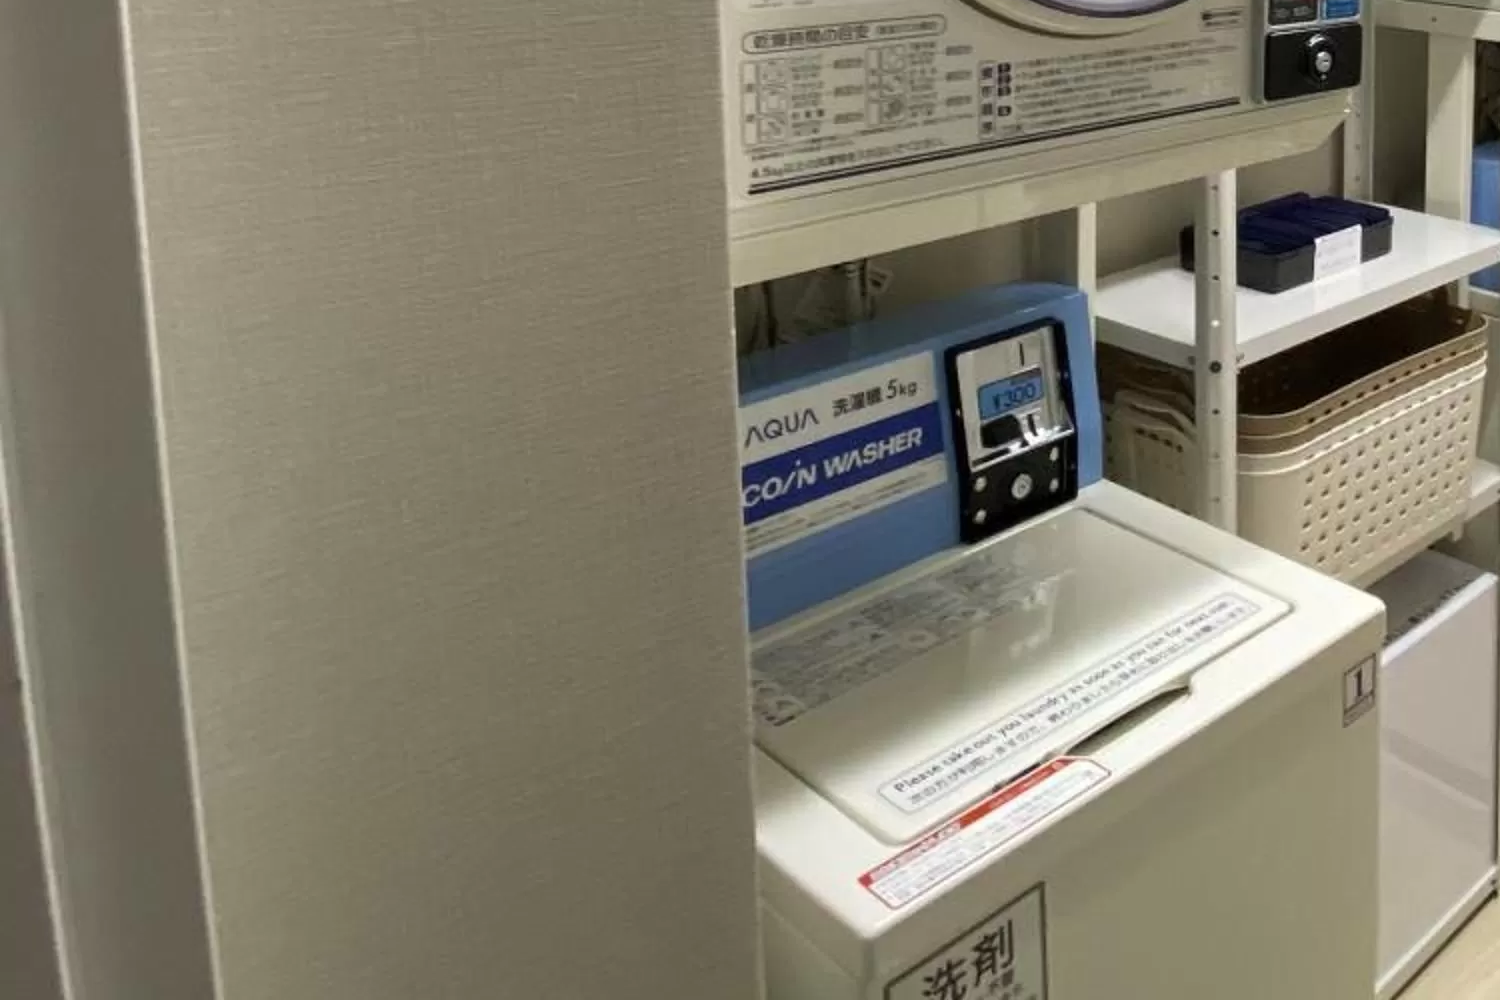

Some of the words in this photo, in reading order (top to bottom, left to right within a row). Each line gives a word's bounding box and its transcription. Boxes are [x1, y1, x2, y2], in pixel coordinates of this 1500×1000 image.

[744, 407, 819, 449] AQUA
[832, 386, 884, 419] 洗濯機
[885, 377, 918, 401] 5kg
[824, 428, 922, 478] WASHER
[894, 759, 943, 793] Please
[944, 745, 973, 767] take
[974, 734, 998, 753] out
[998, 717, 1023, 743] you
[1024, 693, 1071, 723] laundry
[1083, 667, 1112, 691] soon
[922, 919, 1015, 1000] 洗剤
